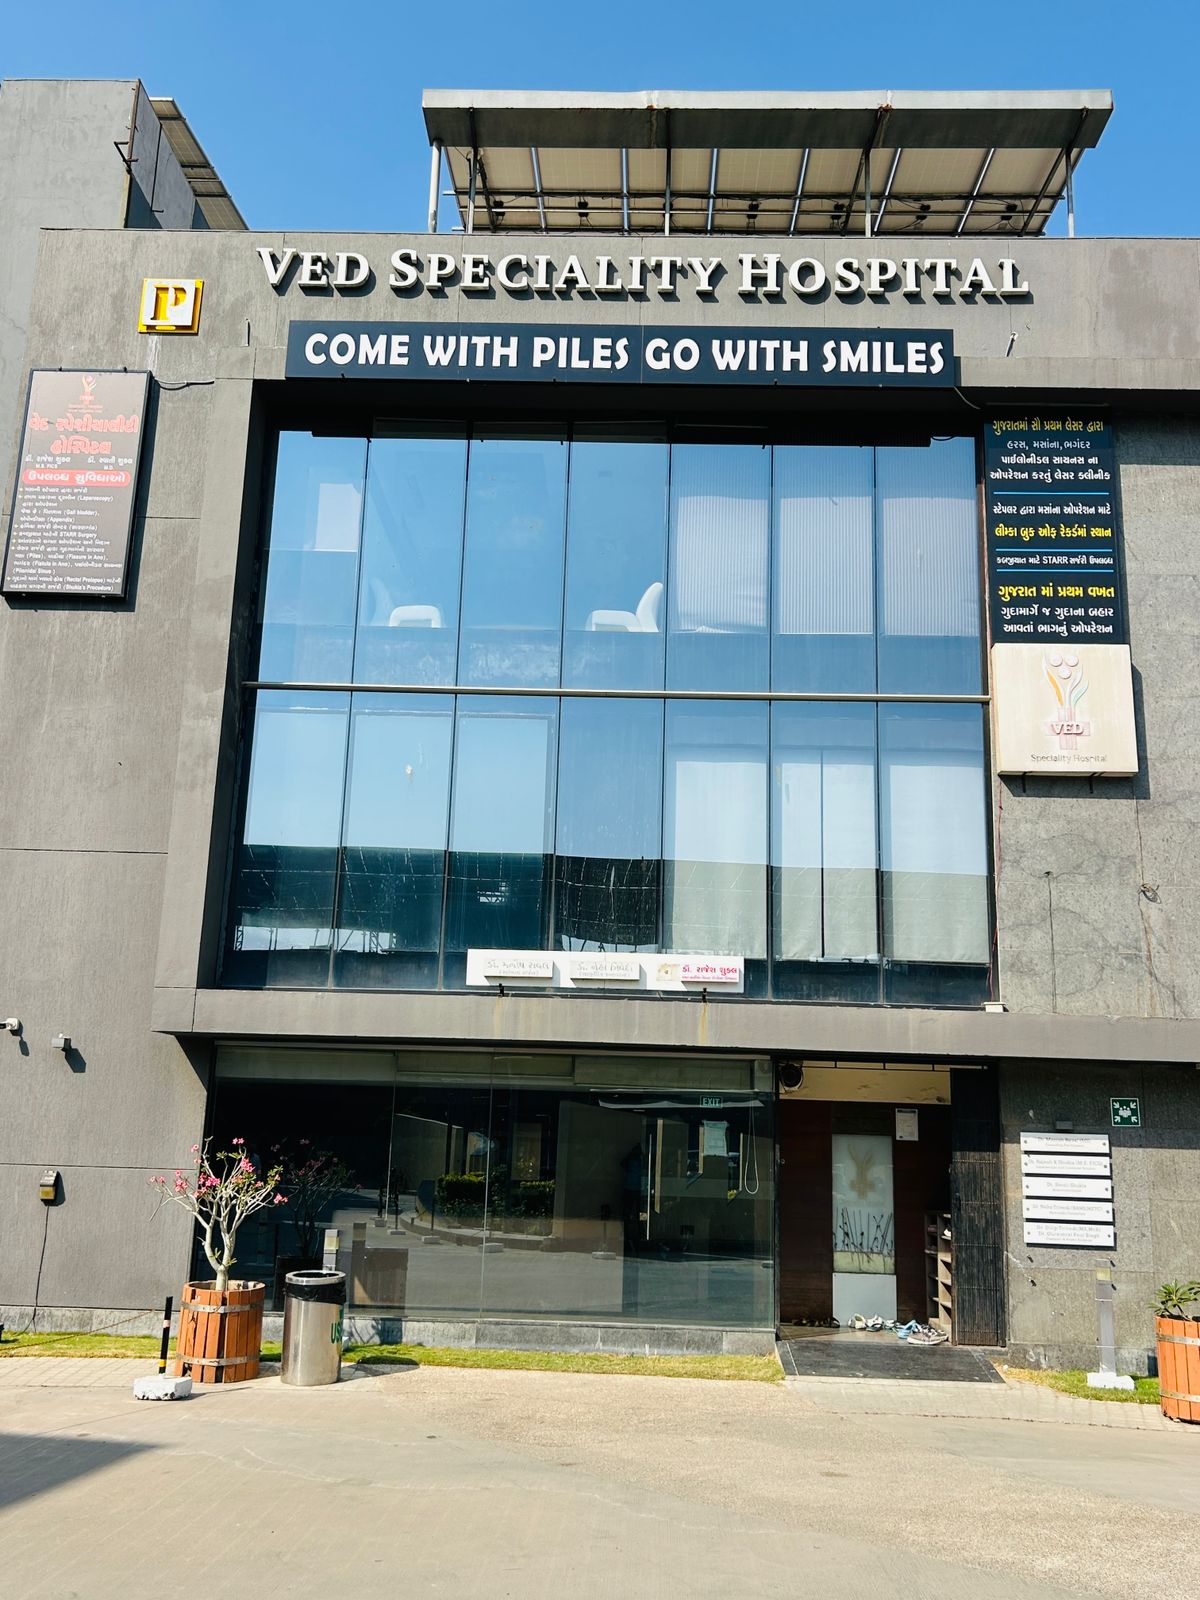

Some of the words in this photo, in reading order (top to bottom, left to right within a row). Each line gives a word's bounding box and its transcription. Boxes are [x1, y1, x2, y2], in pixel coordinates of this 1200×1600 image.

[256, 247, 370, 288] VED
[389, 248, 723, 297] SPECIALITY
[738, 253, 1030, 297] HOSPITAL
[305, 332, 410, 366] COME
[423, 335, 517, 368] WITH
[532, 335, 630, 371] PILES
[645, 337, 700, 371] GO
[712, 339, 808, 372] WITH
[822, 340, 945, 375] SMILES
[993, 417, 1028, 435] ગુજરાતમાં
[1044, 420, 1062, 432] પ્રથમ
[1065, 416, 1083, 431] લેસર
[990, 469, 1028, 480] ઓપરેશન
[1055, 469, 1075, 480] લેસર
[1042, 556, 1068, 564] STARR
[998, 586, 1036, 602] ગુજરાત
[1041, 583, 1053, 597] માં
[1057, 586, 1083, 597] પ્રથમ
[1088, 586, 1114, 597] વખત
[1042, 608, 1051, 616] જ
[1088, 607, 1114, 617] બહાર
[1071, 621, 1112, 633] ઓપરેશન
[1051, 723, 1083, 735] VED
[1031, 754, 1071, 763] Speciality
[702, 1098, 720, 1106] EXIT
